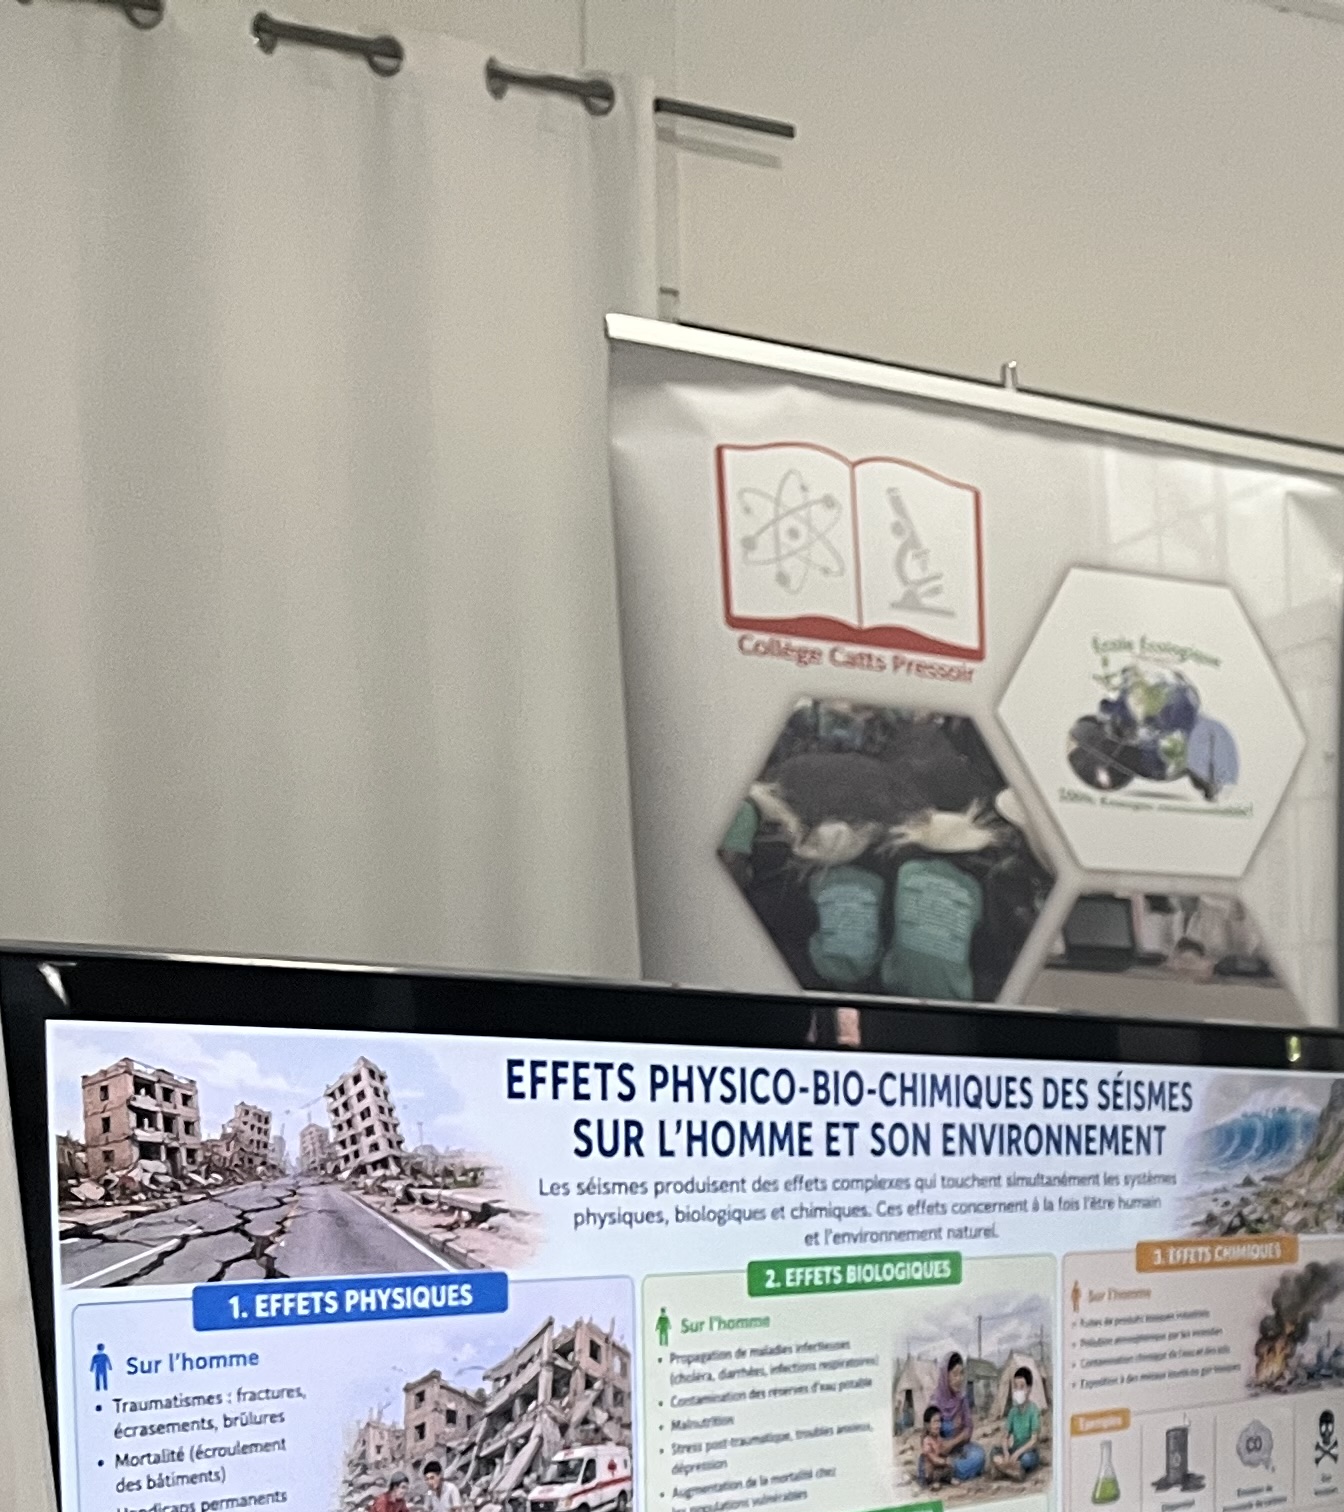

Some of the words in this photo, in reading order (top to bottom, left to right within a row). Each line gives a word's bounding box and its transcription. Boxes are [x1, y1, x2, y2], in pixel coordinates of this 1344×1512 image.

[738, 633, 823, 667] Collège
[507, 1059, 636, 1102] EFFETS
[650, 1064, 1033, 1109] PHYSICO-BIO-CHIMIQUES
[1043, 1077, 1088, 1110] DES
[1098, 1071, 1193, 1112] SÉISMES
[573, 1118, 644, 1158] SUR
[659, 1119, 813, 1157] L'HOMME
[826, 1122, 860, 1157] ET
[870, 1122, 930, 1157] SON
[942, 1123, 1166, 1156] ENVIRONNEMENT
[539, 1178, 570, 1196] Les
[577, 1177, 648, 1195] séismes
[654, 1177, 746, 1198] produisent
[752, 1176, 779, 1192] des
[784, 1175, 827, 1192] effets
[832, 1175, 911, 1193] complexes
[915, 1177, 936, 1193] qui
[941, 1174, 1002, 1189] touchent
[1103, 1172, 1120, 1186] les
[765, 1269, 781, 1288] 2.
[785, 1265, 843, 1287] EFFETS
[846, 1260, 951, 1284] BIOLOGIQUES
[228, 1296, 248, 1319] 1.
[255, 1290, 338, 1317] EFFETS
[345, 1283, 473, 1313] PHYSIQUES
[127, 1357, 162, 1375] Sur
[169, 1352, 259, 1372] l'homme
[112, 1394, 223, 1413] Traumatismes
[237, 1387, 306, 1402] fractures,
[114, 1418, 218, 1439] écrasements,
[223, 1412, 285, 1428] brûlures
[115, 1447, 184, 1467] Mortalité
[190, 1438, 286, 1462] (écroulement
[116, 1477, 142, 1493] des
[146, 1466, 226, 1490] bâtiments)
